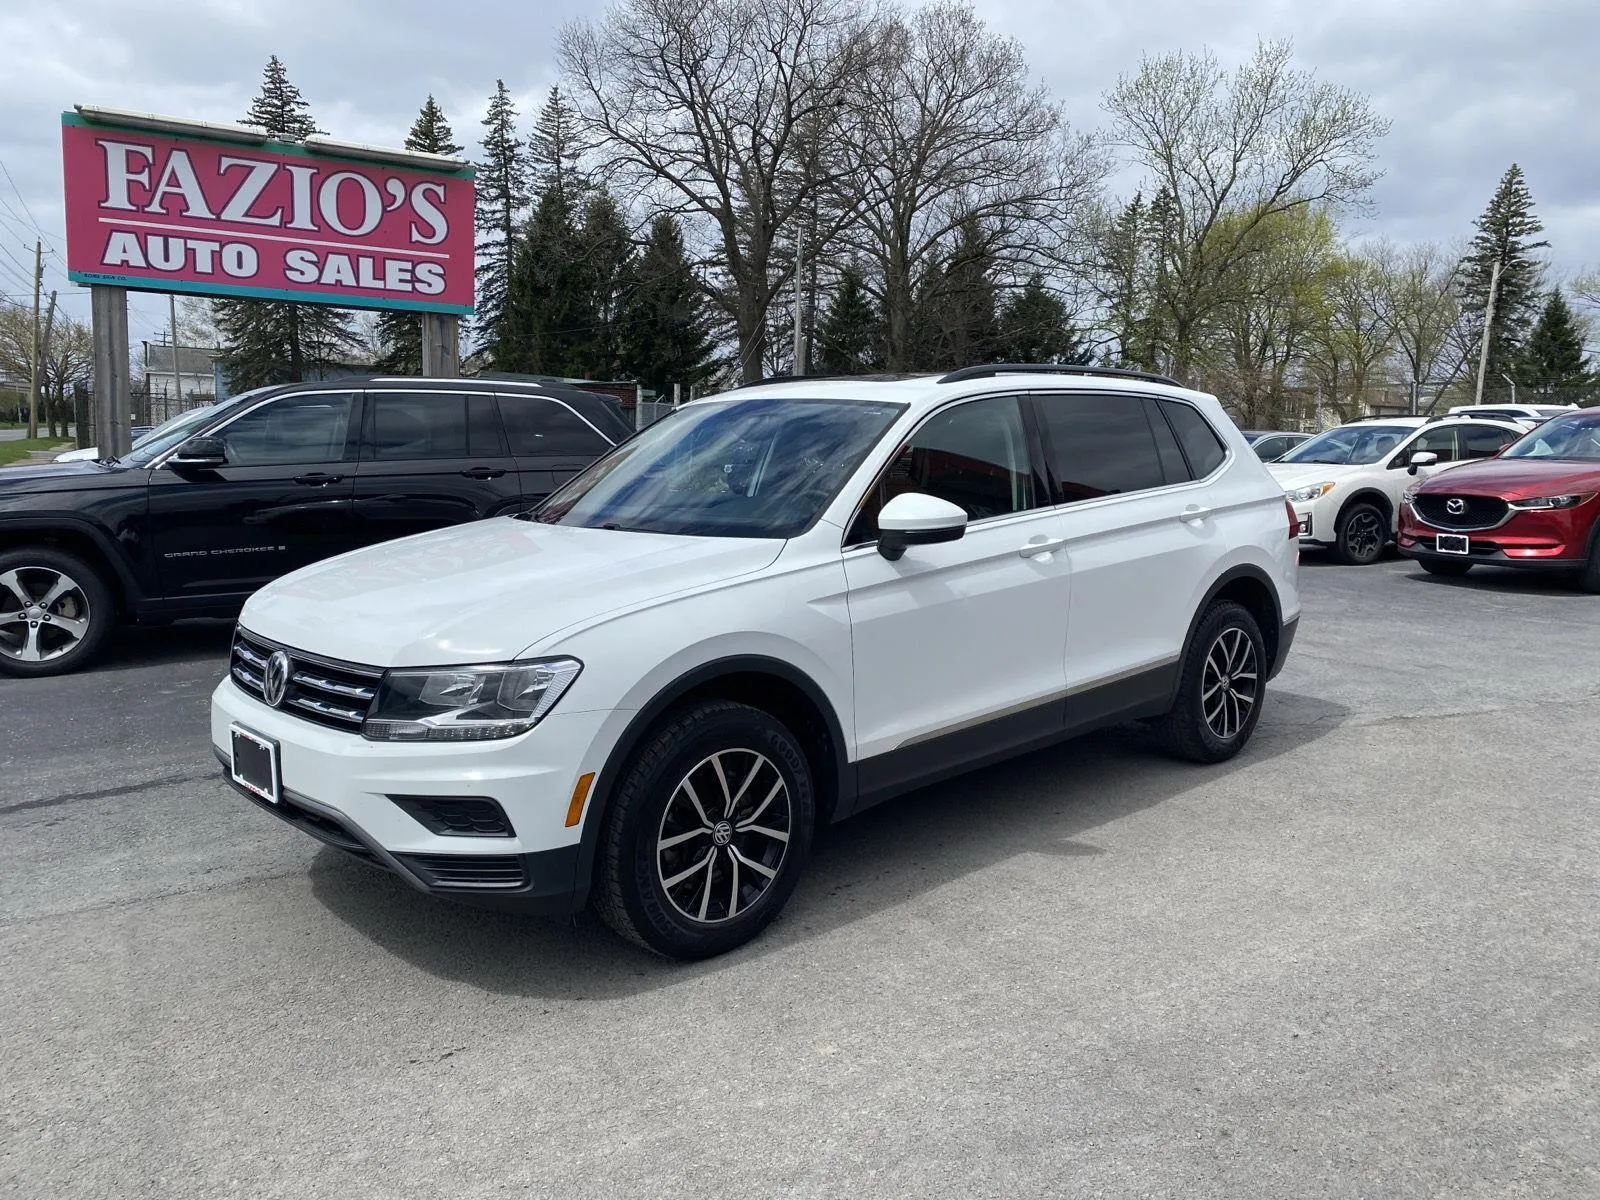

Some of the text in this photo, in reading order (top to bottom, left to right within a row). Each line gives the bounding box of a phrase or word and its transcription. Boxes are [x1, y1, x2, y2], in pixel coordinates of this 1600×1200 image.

[97, 139, 449, 244] FAZIO'S
[102, 231, 446, 295] AUTO SALES
[164, 550, 207, 558] GRAND
[210, 546, 275, 555] CHEROKEE
